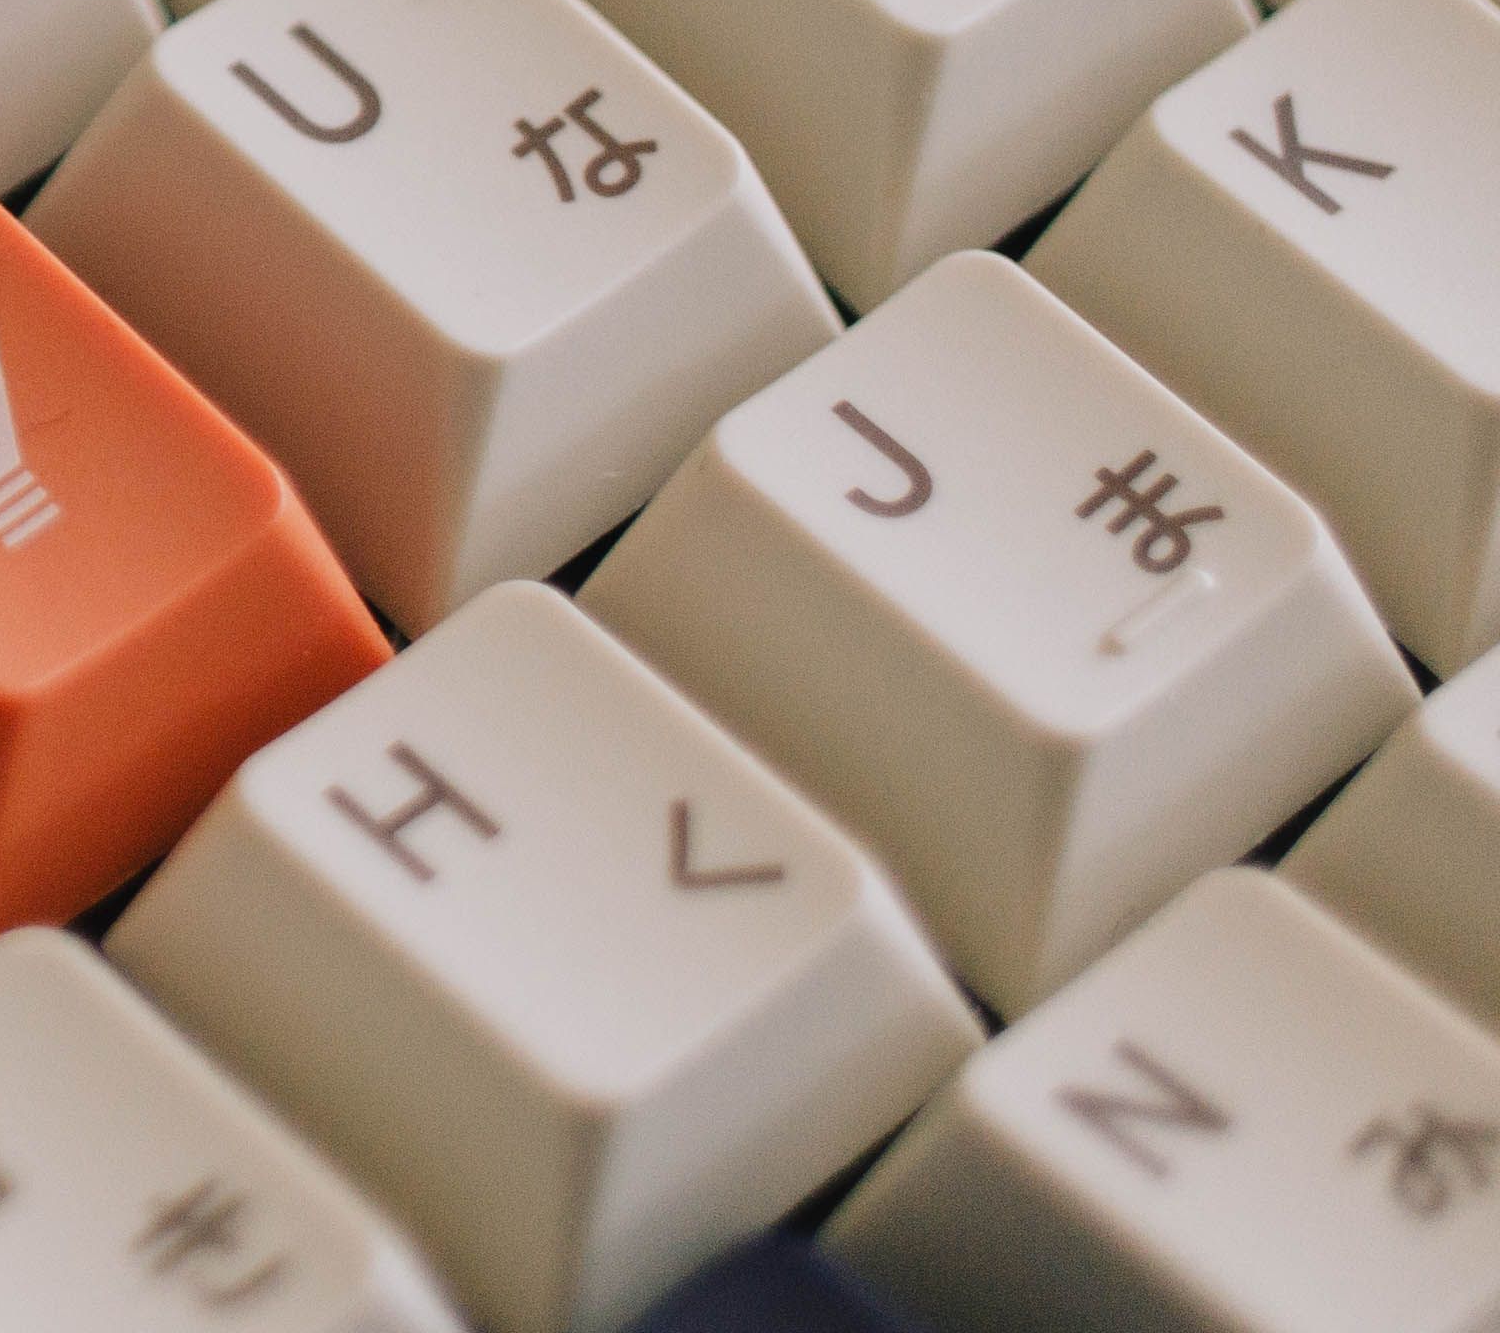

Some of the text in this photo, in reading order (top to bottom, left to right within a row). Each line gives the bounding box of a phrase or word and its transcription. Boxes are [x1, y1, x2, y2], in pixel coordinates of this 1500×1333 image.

[230, 24, 382, 145] U
[511, 86, 659, 203] な
[1228, 92, 1397, 216] K
[832, 399, 935, 519] J
[1073, 447, 1225, 576] ま
[321, 738, 502, 883] H
[1055, 1038, 1235, 1179] N
